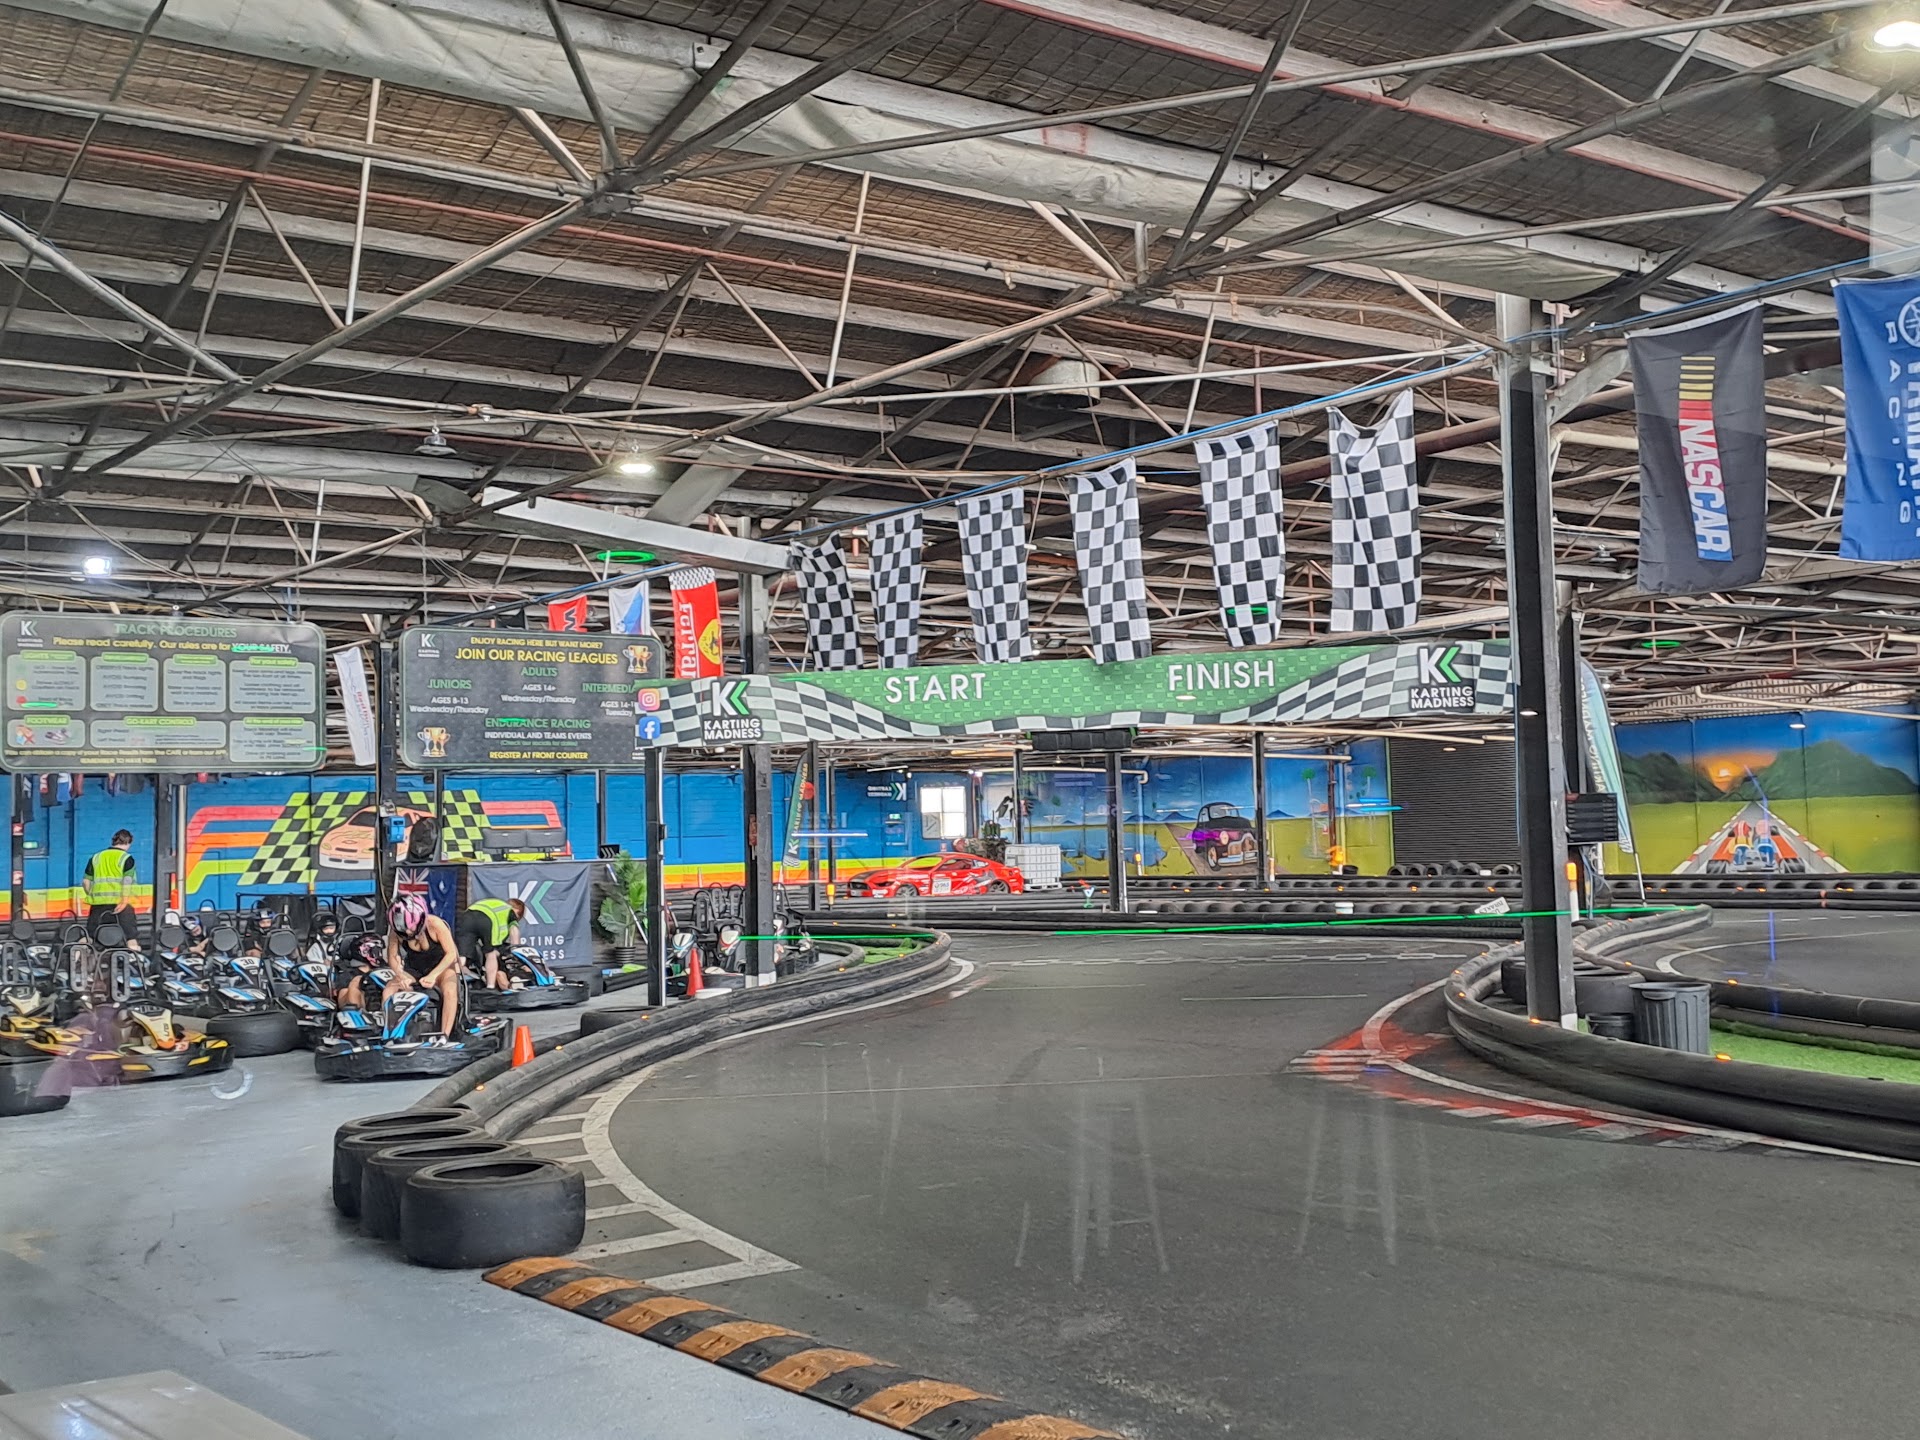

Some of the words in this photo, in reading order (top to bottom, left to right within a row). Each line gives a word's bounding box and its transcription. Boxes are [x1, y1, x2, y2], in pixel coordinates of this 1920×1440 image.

[1885, 321, 1911, 524] RACING
[1679, 418, 1731, 554] NASCAR
[115, 624, 155, 635] TRACK
[160, 625, 237, 638] PROCEDURES
[52, 636, 84, 646] Please
[112, 640, 156, 649] carefully.
[179, 641, 200, 650] rules
[679, 602, 700, 678] Ferrar
[455, 648, 485, 659] JOIN
[488, 649, 514, 660] OUR
[518, 650, 566, 662] RACING
[569, 652, 618, 664] LEAGUES
[521, 667, 558, 677] ADULTS
[427, 679, 472, 689] JUNIORS
[884, 673, 987, 703] START
[1168, 660, 1276, 691] FINISH
[582, 683, 636, 693] INTERMEDIA
[1411, 686, 1473, 699] KARTING
[501, 695, 576, 704] Wednesday/Thursday
[1411, 696, 1474, 709] MADNESS
[409, 705, 489, 714] Wednesday/Thursday
[485, 718, 550, 728] ENDURANCE
[551, 719, 591, 728] RACING
[704, 719, 761, 730] KARTING
[704, 728, 762, 740] MADNESS
[520, 935, 565, 945] RTING
